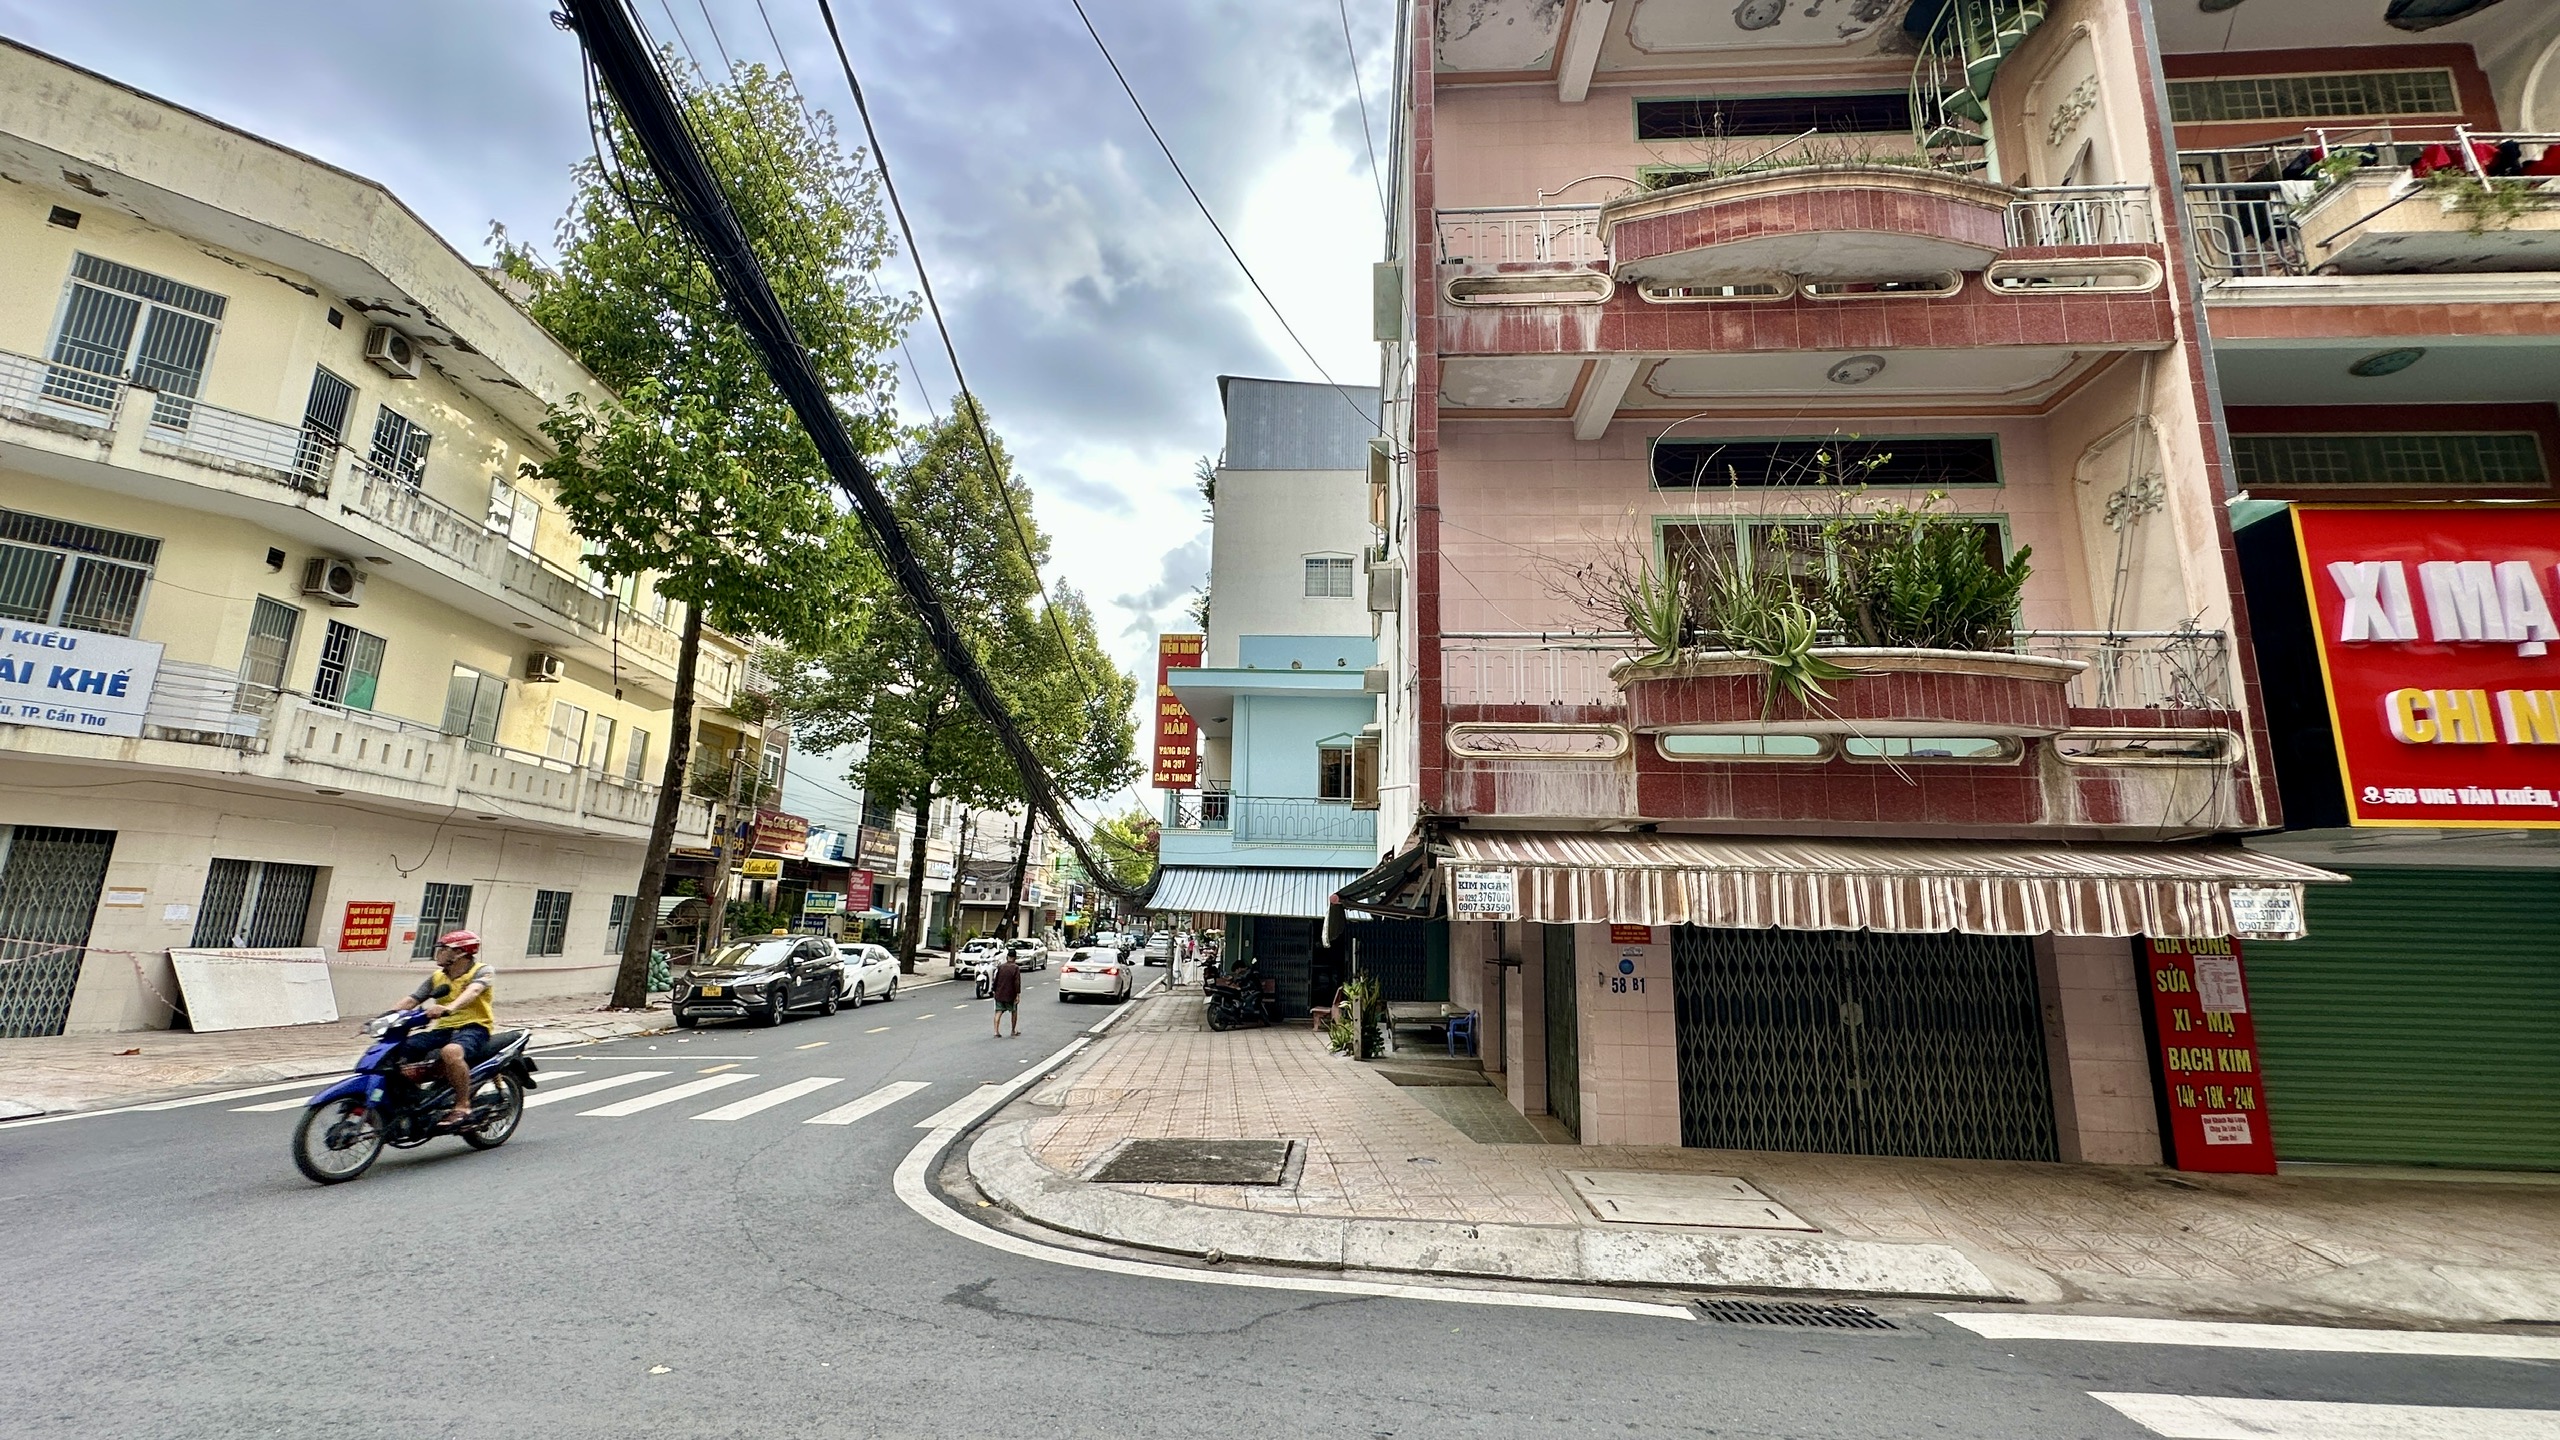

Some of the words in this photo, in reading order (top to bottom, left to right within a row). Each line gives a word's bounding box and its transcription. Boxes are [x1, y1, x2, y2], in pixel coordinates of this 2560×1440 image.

[2327, 560, 2418, 642] XI
[2418, 560, 2560, 657] MẠ
[47, 666, 133, 698] KHẾ
[21, 704, 40, 718] TP.
[46, 707, 76, 722] Cần
[80, 712, 108, 726] Thơ
[1164, 718, 1188, 734] HÂN
[2385, 687, 2497, 744] CHI
[2496, 689, 2560, 744] N
[2383, 788, 2418, 804] 56B
[2418, 788, 2458, 804] UNG
[2456, 786, 2495, 805] VĂN
[2494, 786, 2558, 808] KHIÊM,
[1458, 882, 1478, 890] KIM
[1480, 880, 1510, 891] NGÂN
[1458, 902, 1511, 912] 0907.537590
[1612, 977, 1626, 994] 58
[1632, 978, 1644, 994] B1
[2156, 962, 2191, 992] SỬA
[2173, 1008, 2192, 1032] XI
[2207, 1011, 2236, 1038] MẠ
[2168, 1047, 2214, 1076] BẠCH
[2217, 1048, 2252, 1072] KIM
[2204, 1086, 2226, 1108] 18K
[2234, 1086, 2256, 1110] 24K
